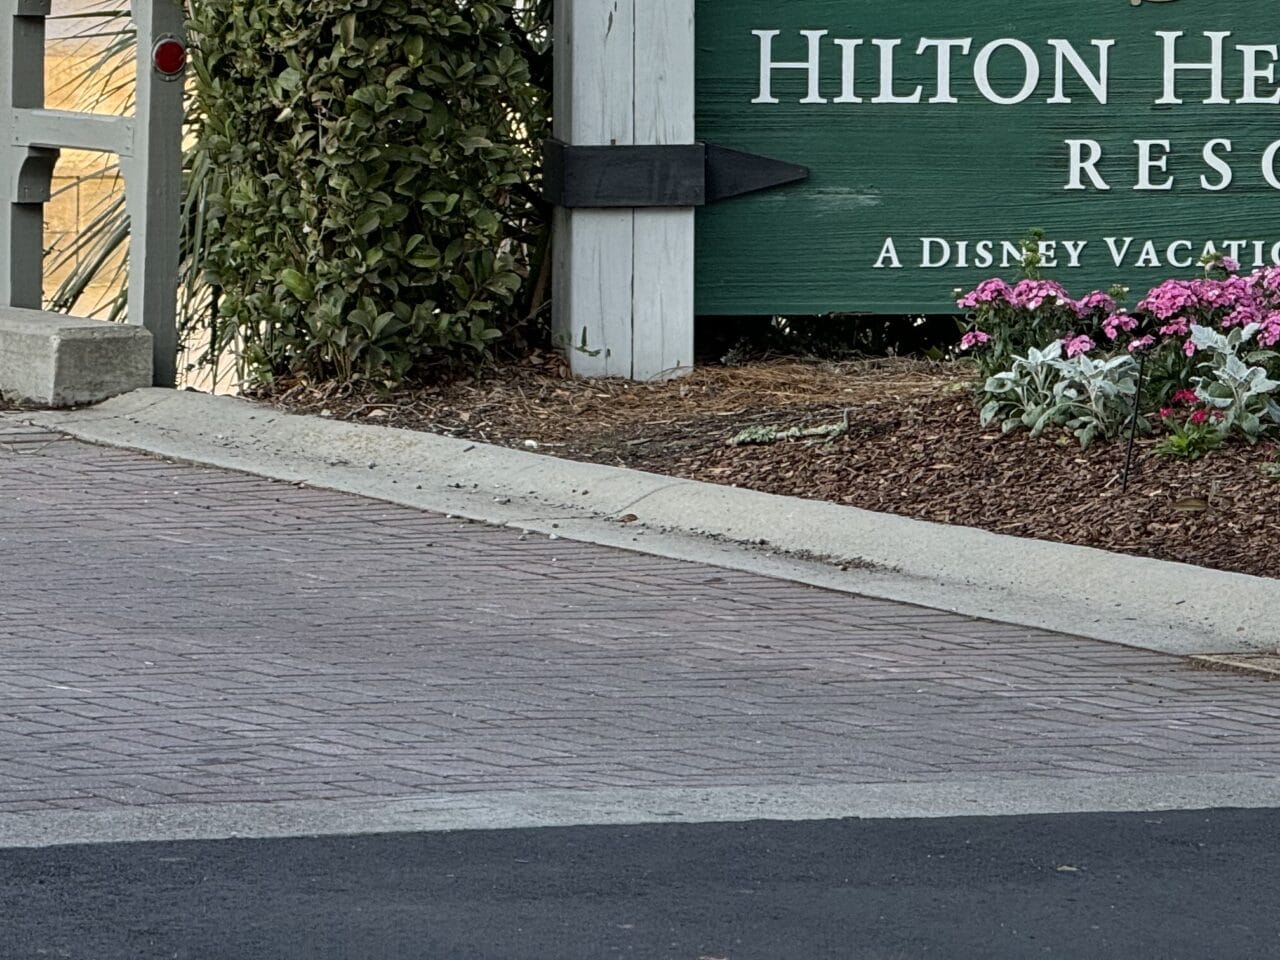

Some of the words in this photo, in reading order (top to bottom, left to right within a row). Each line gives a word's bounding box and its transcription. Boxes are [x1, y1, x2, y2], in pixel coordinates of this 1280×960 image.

[750, 29, 1115, 105] HILTON
[872, 237, 903, 268] A
[919, 237, 1088, 268] DISNEY
